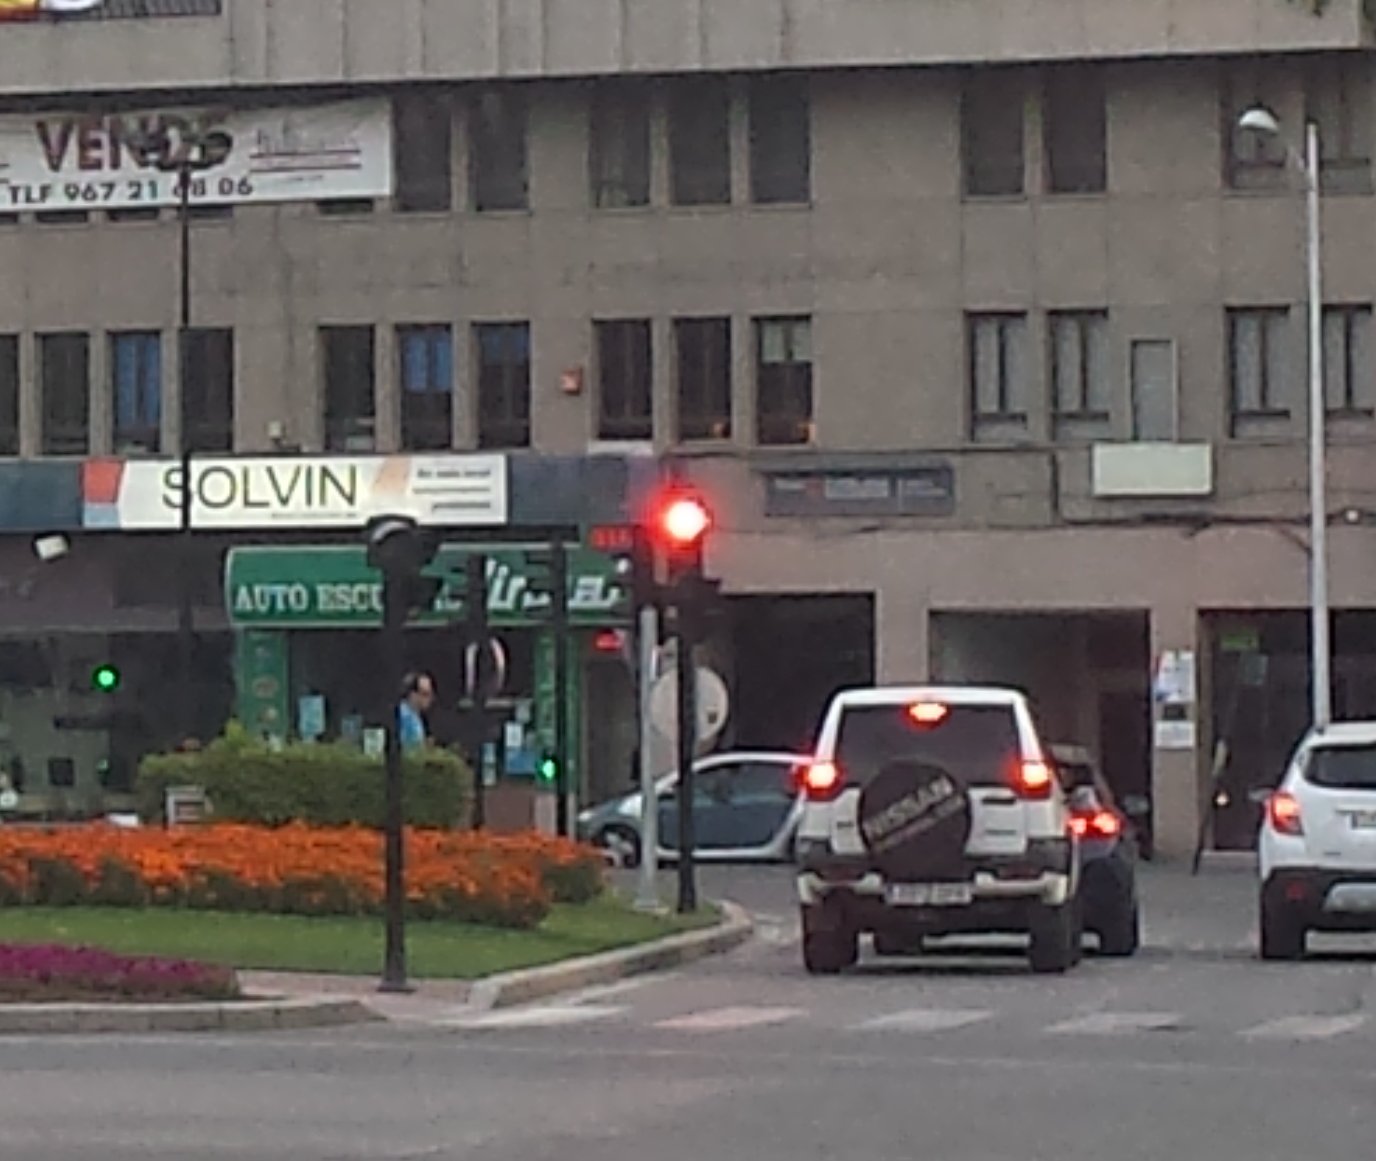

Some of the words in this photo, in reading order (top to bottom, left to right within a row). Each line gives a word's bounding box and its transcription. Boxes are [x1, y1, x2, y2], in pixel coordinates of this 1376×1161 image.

[64, 181, 116, 202] 967
[128, 179, 159, 200] 21
[218, 176, 253, 196] 06
[162, 464, 357, 509] SOLVIN
[234, 582, 309, 613] AUTO
